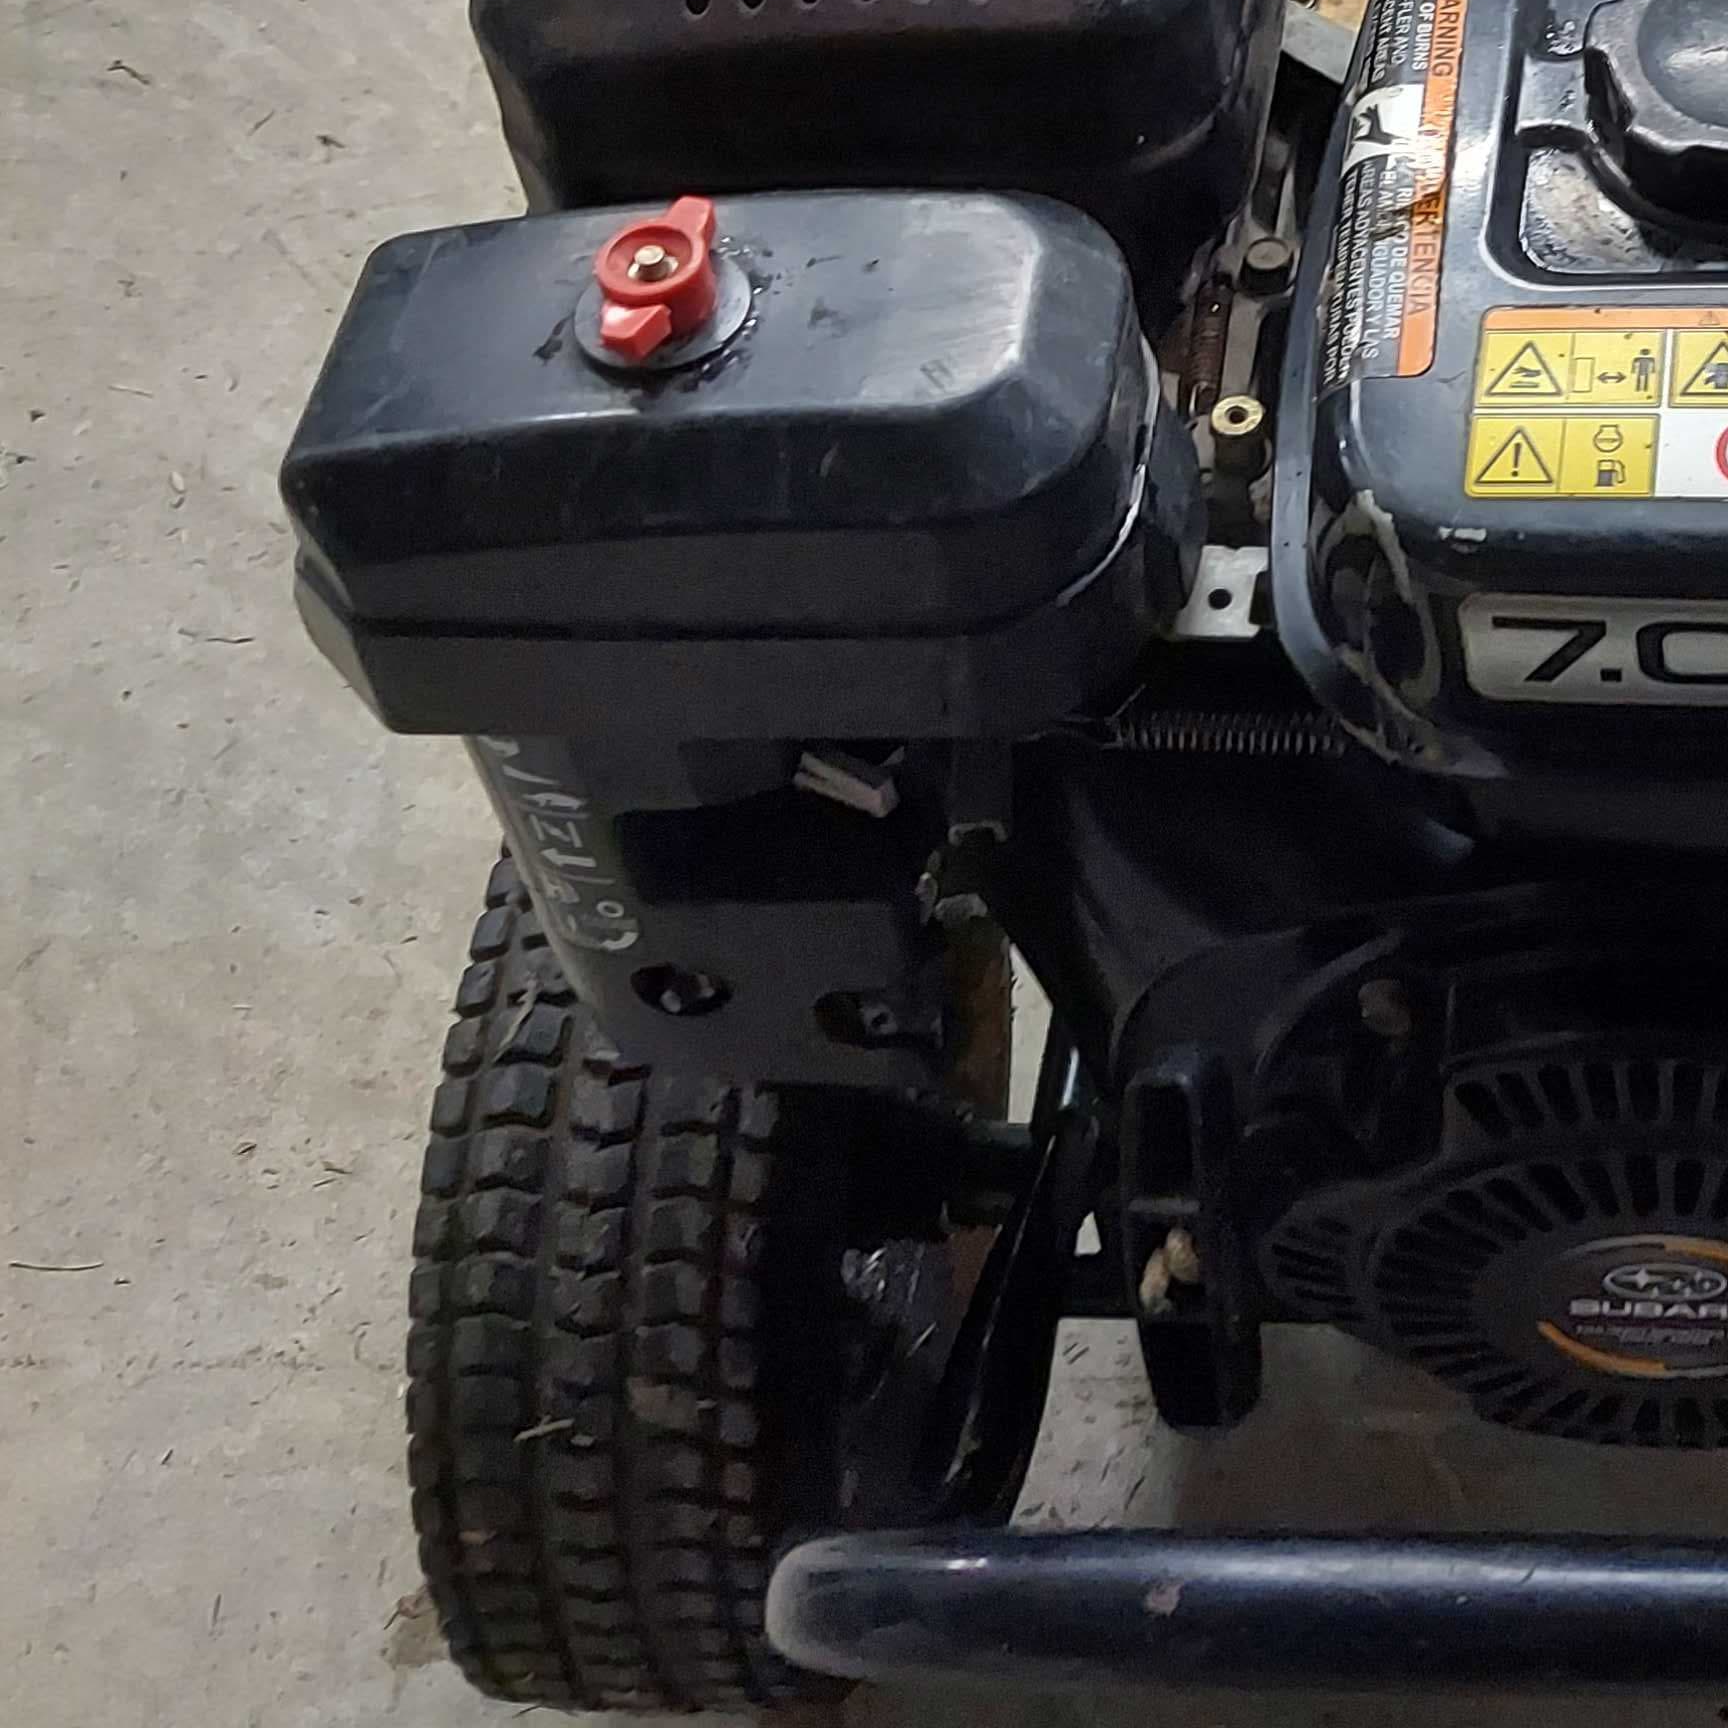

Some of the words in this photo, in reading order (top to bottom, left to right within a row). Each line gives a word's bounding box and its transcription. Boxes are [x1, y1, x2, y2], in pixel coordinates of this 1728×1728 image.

[1418, 3, 1436, 22] OF
[1391, 35, 1410, 66] AND
[1411, 23, 1433, 71] BURNS
[1390, 243, 1409, 268] DE
[1383, 271, 1406, 340] QUEMAR
[1361, 327, 1381, 360] LAS
